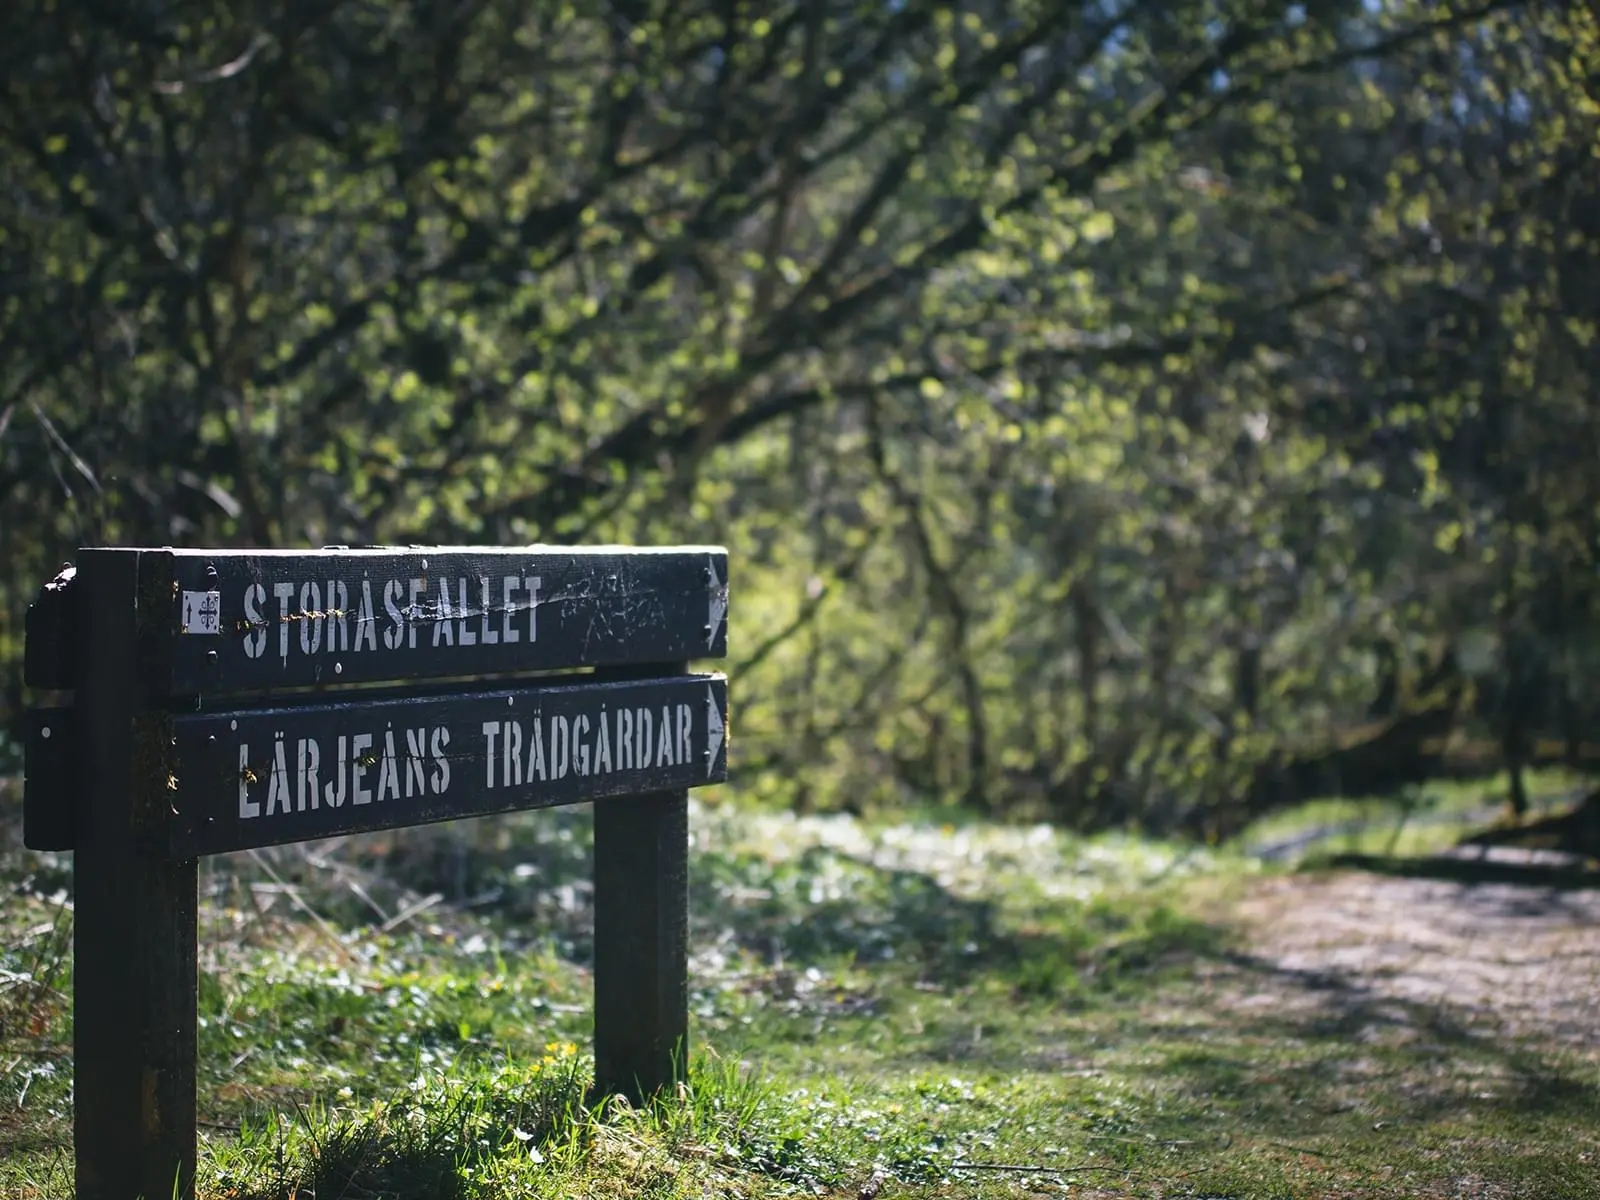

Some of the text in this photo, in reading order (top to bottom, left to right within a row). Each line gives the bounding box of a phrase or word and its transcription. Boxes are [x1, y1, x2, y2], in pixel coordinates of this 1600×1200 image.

[243, 571, 542, 658] STORÅSFALLET
[239, 703, 692, 818] LÄRJEÅNS TRÄDGÅRDAR
